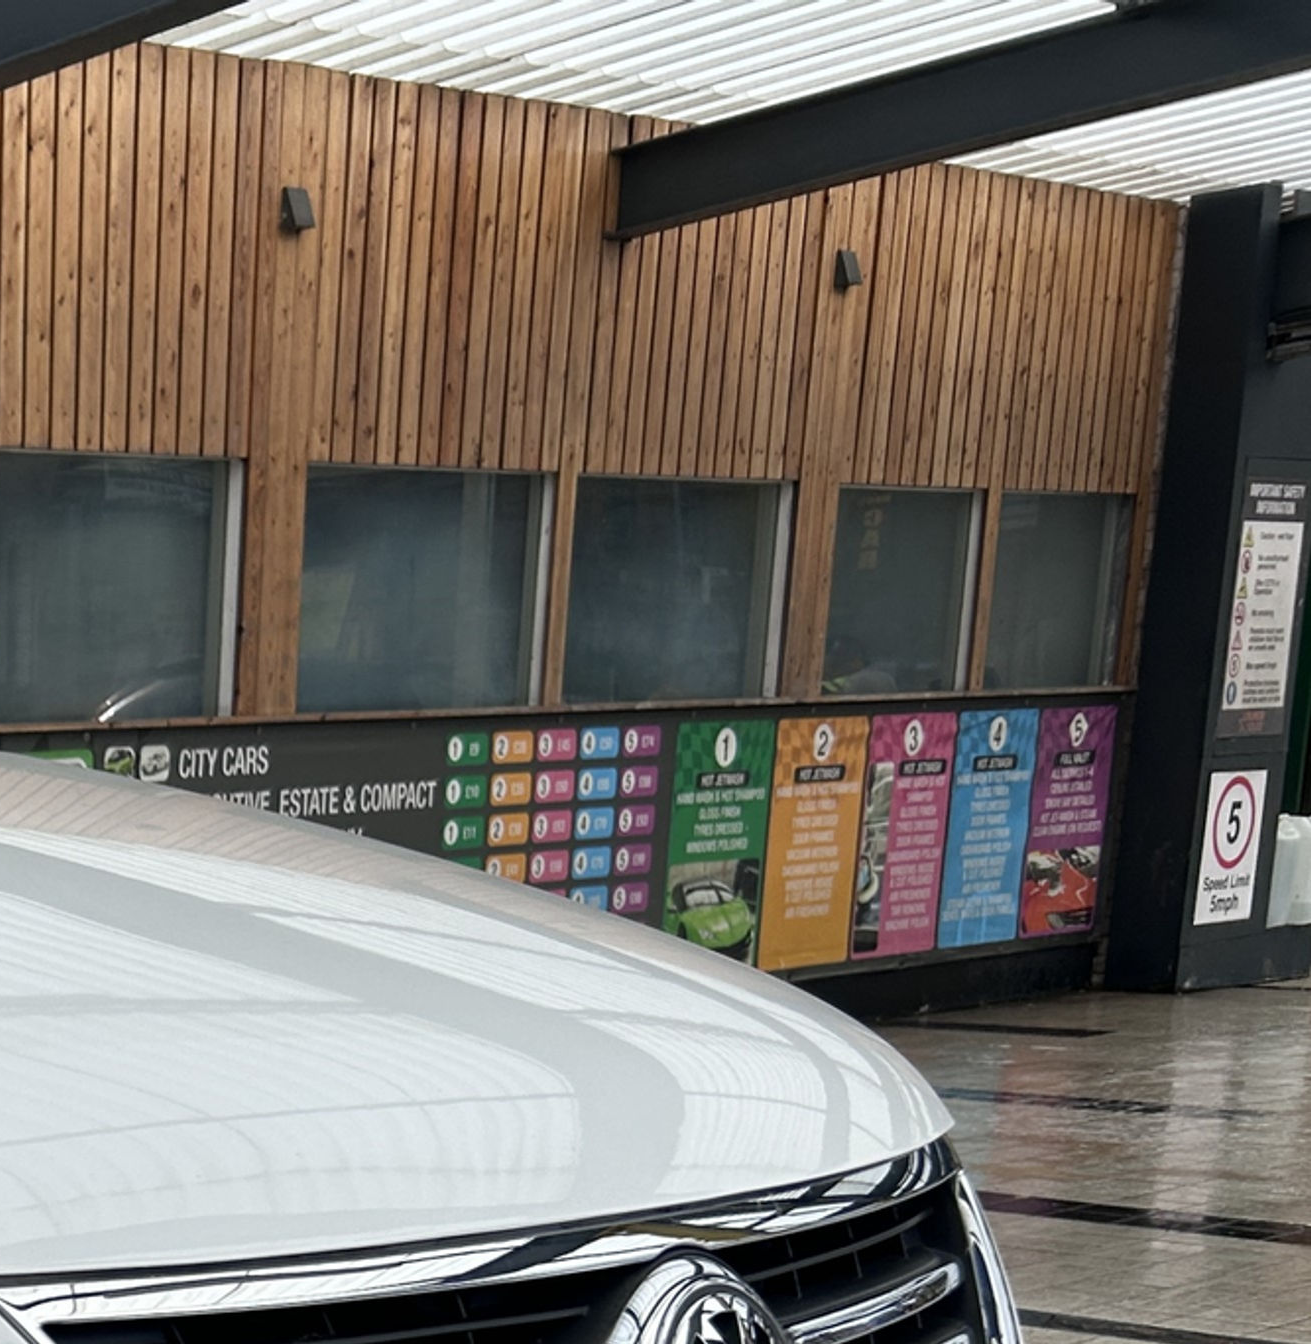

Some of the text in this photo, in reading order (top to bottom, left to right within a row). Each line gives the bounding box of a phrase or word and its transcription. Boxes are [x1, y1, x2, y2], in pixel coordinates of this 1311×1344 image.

[817, 730, 828, 756] 2
[909, 725, 919, 752] 3
[178, 744, 270, 780] CITY CARS
[279, 786, 339, 818] ESTATE
[342, 784, 355, 813] &
[361, 780, 437, 812] COMPACT
[1226, 800, 1243, 845] 5
[1203, 873, 1250, 894] Speed Limit
[1209, 894, 1239, 916] 5mph
